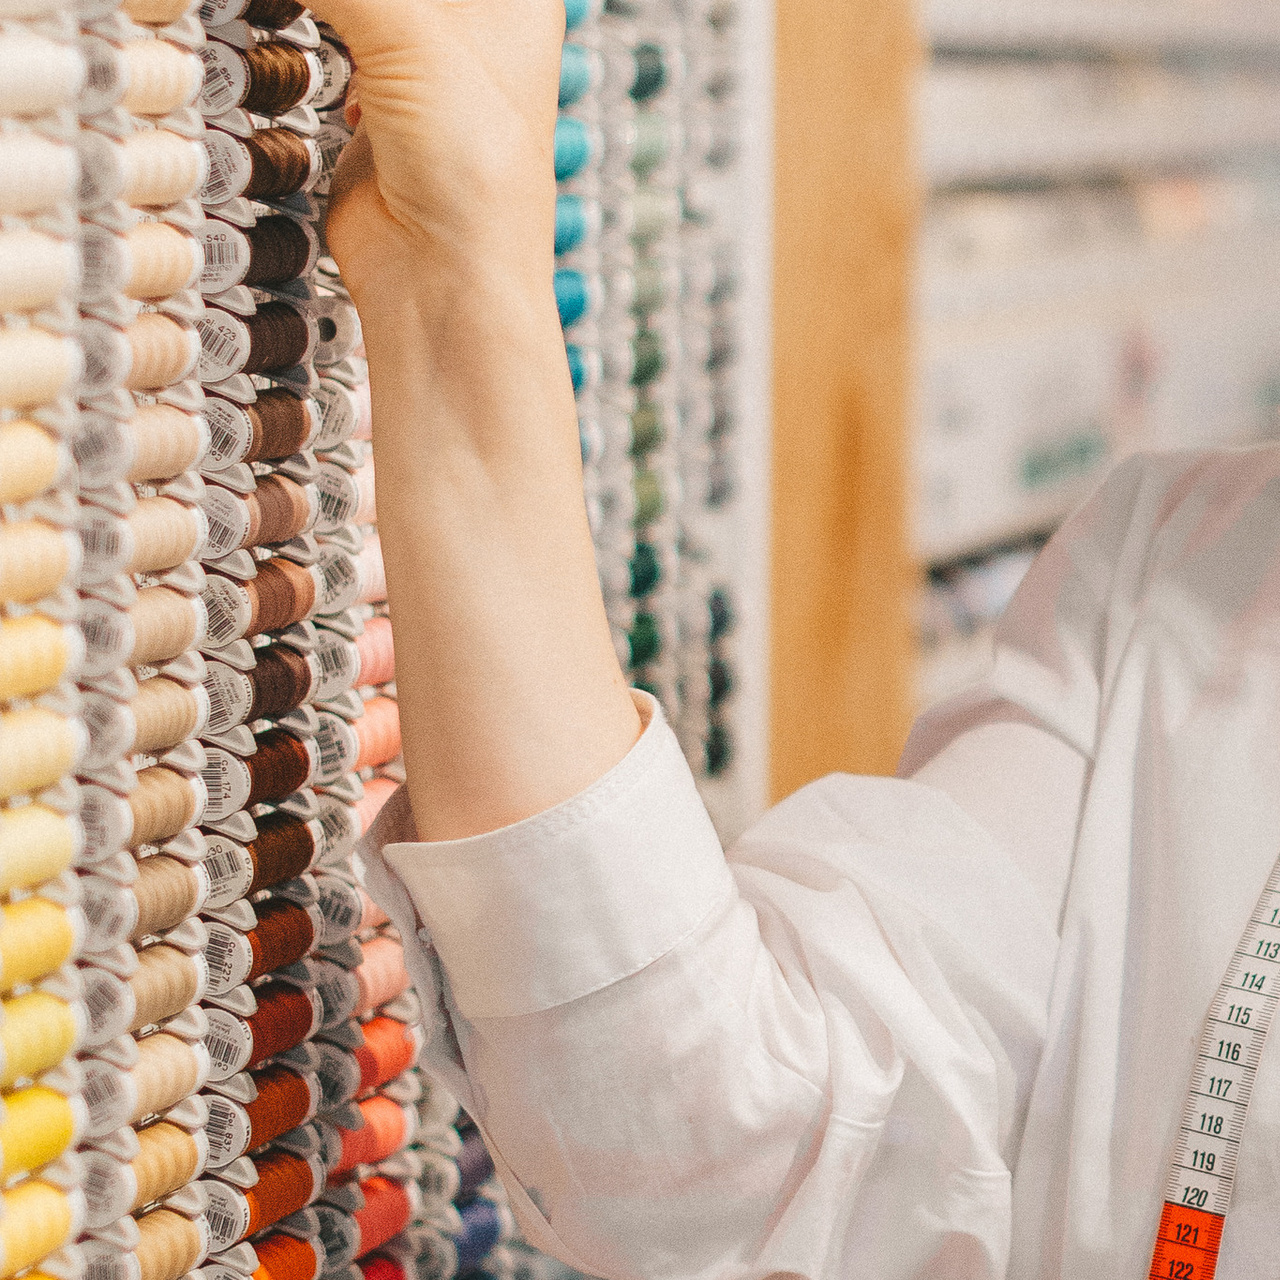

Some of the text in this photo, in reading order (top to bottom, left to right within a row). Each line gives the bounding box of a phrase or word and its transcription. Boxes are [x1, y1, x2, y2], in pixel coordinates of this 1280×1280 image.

[205, 233, 227, 242] 540
[217, 324, 237, 342] 423
[222, 781, 232, 800] 174
[1256, 939, 1280, 959] 113
[221, 963, 233, 983] 227
[1241, 971, 1266, 991] 114
[1227, 1004, 1253, 1025] 115
[1218, 1039, 1242, 1062] 116
[1209, 1076, 1233, 1097] 117
[1200, 1112, 1224, 1135] 118
[1192, 1149, 1216, 1171] 119
[1182, 1185, 1209, 1208] 120
[1176, 1223, 1199, 1245] 121
